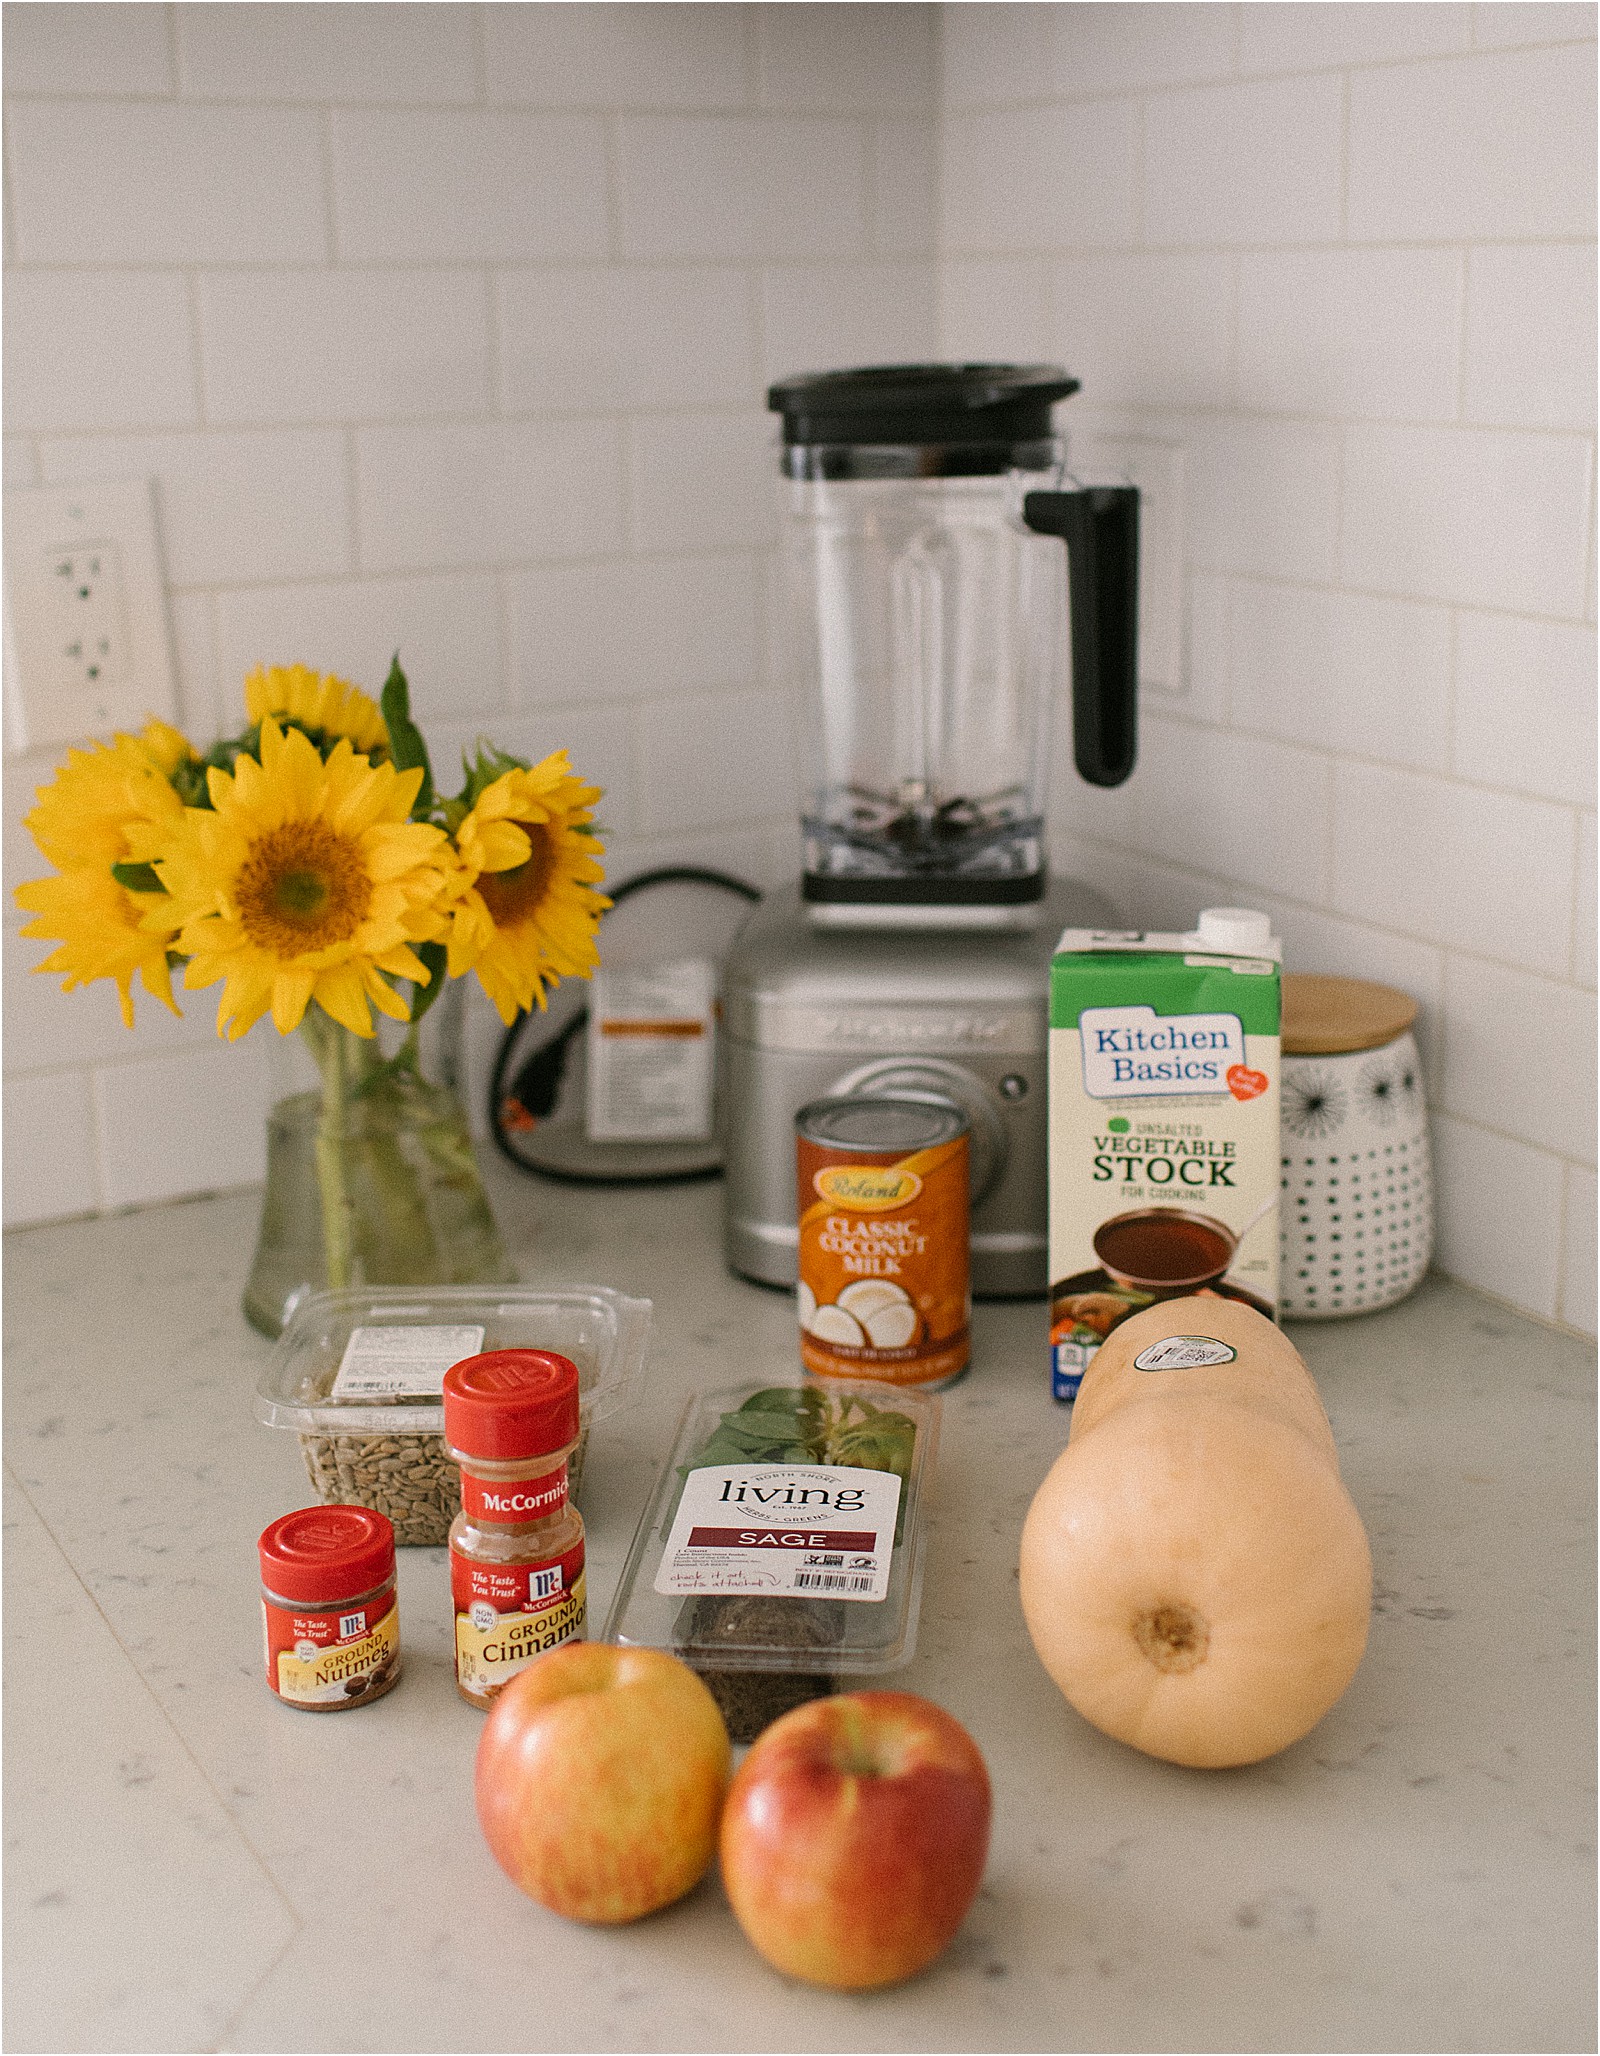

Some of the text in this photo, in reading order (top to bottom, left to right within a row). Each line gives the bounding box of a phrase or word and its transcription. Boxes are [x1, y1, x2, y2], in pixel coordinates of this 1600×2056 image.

[1095, 1026, 1230, 1053] Kitchen
[1113, 1056, 1218, 1082] Basics
[1136, 1122, 1203, 1136] UNSALTED
[1093, 1136, 1236, 1158] VEGETABLE
[1093, 1155, 1236, 1186] STOCK
[831, 1175, 904, 1199] Roland
[1120, 1186, 1206, 1201] FOR COOKING
[826, 1215, 920, 1238] CLASSIC
[818, 1232, 930, 1257] COCONUT
[843, 1255, 902, 1275] MILK
[755, 1473, 836, 1484] NORTH SHORE
[481, 1475, 570, 1512] McCormick
[718, 1480, 866, 1511] living
[743, 1506, 829, 1522] HERBS GREENS
[738, 1532, 827, 1547] SAGE
[471, 1571, 516, 1585] The Taste
[471, 1583, 489, 1595] You
[523, 1590, 569, 1612] McCormick
[475, 1608, 493, 1618] NON
[475, 1616, 494, 1626] GMO
[508, 1597, 578, 1641] GROUND
[293, 1619, 328, 1629] The Taste
[293, 1628, 306, 1637] You
[335, 1630, 371, 1645] McCormick
[323, 1633, 383, 1669] GROUND
[315, 1640, 390, 1687] Nutmeg
